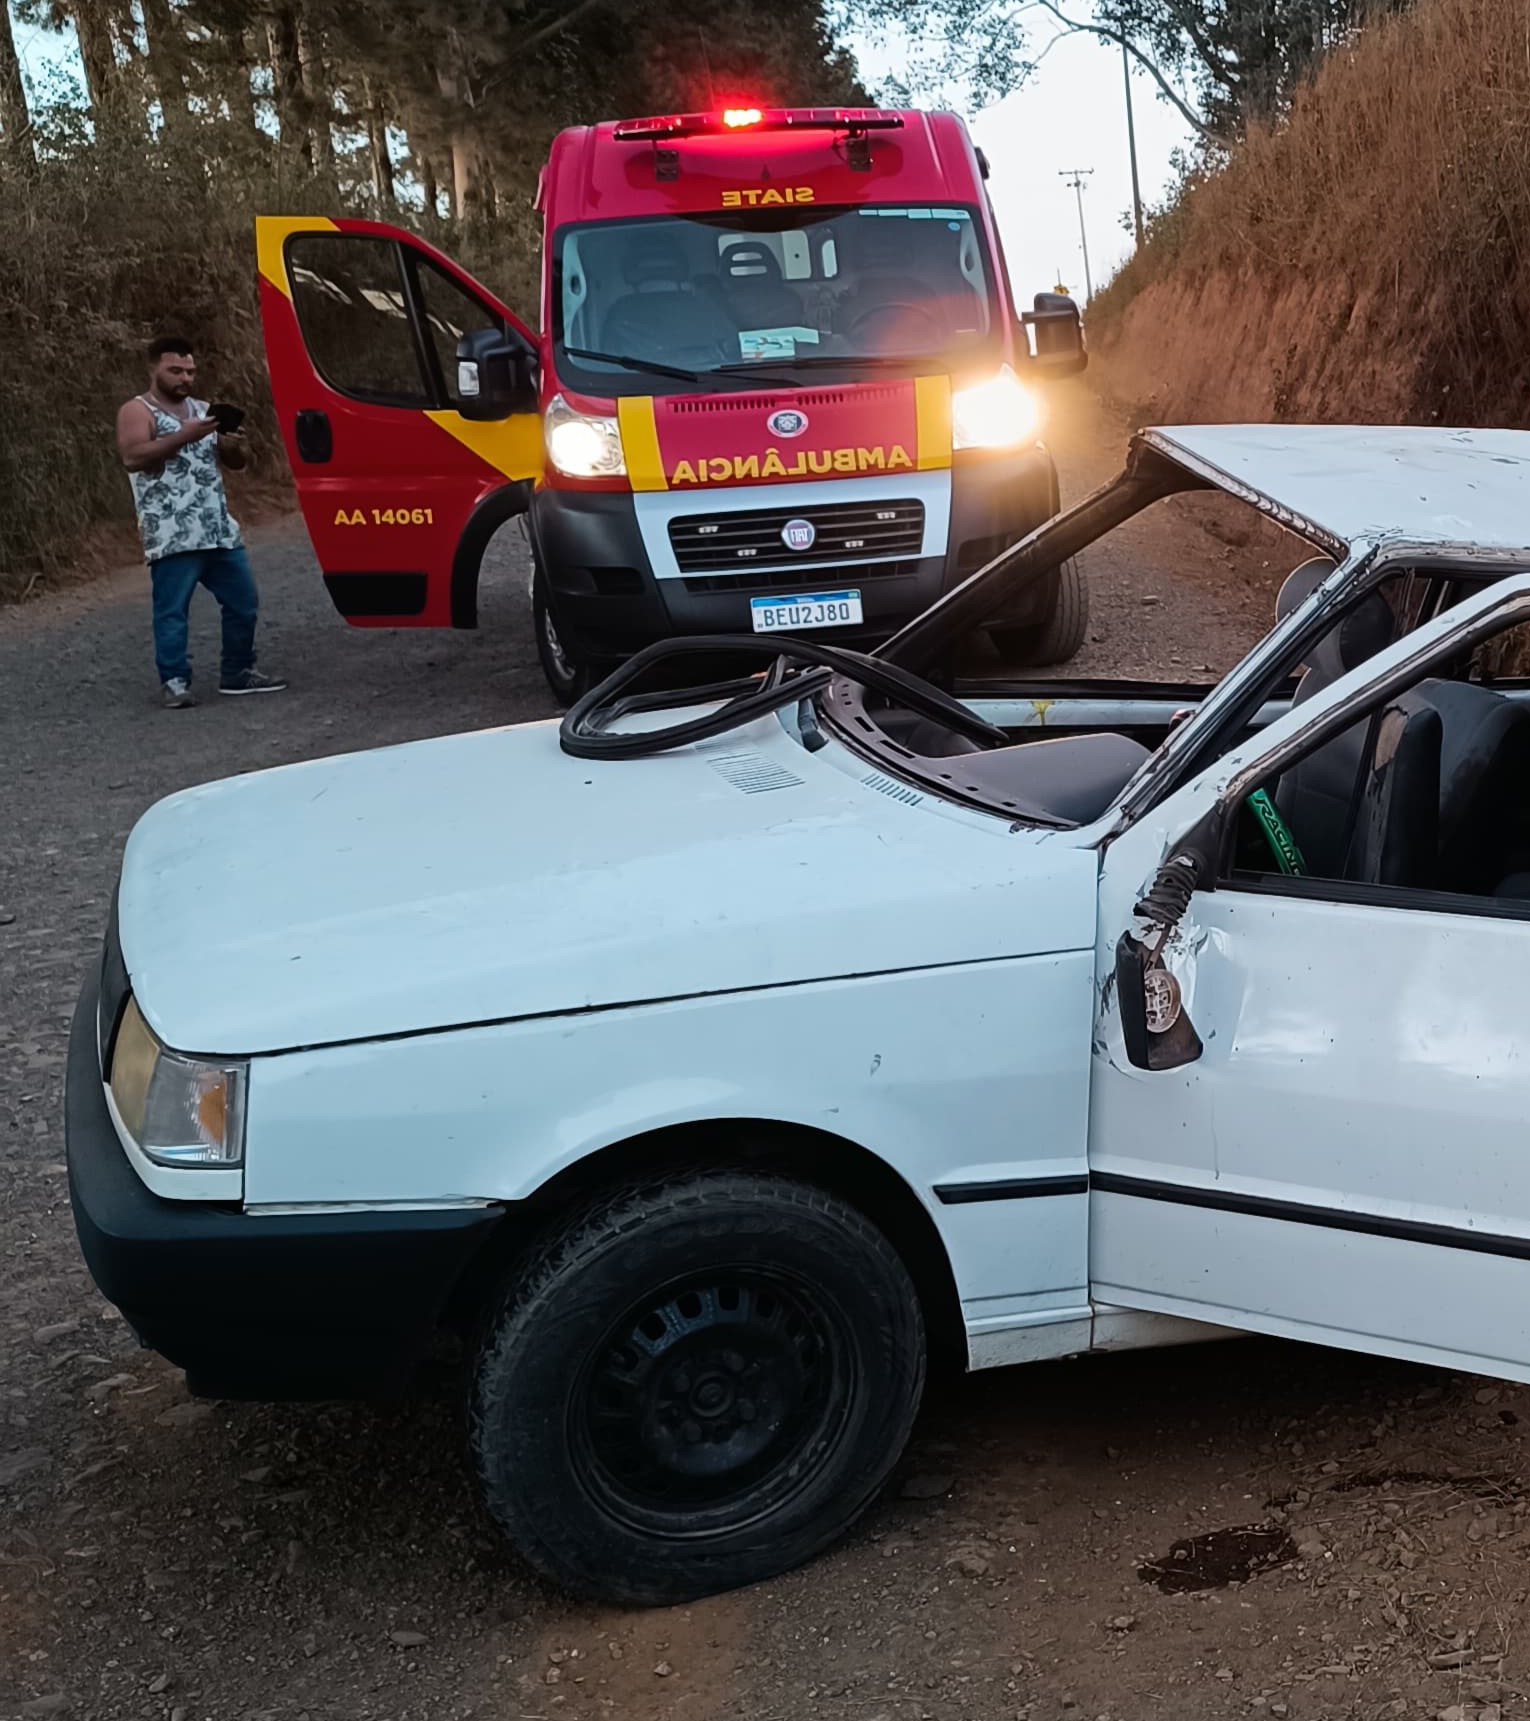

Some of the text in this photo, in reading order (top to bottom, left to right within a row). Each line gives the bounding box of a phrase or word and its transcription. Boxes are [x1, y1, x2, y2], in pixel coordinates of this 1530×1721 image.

[334, 508, 433, 525] AA 14061
[790, 528, 809, 543] FIAT
[763, 602, 851, 627] BEU2J80
